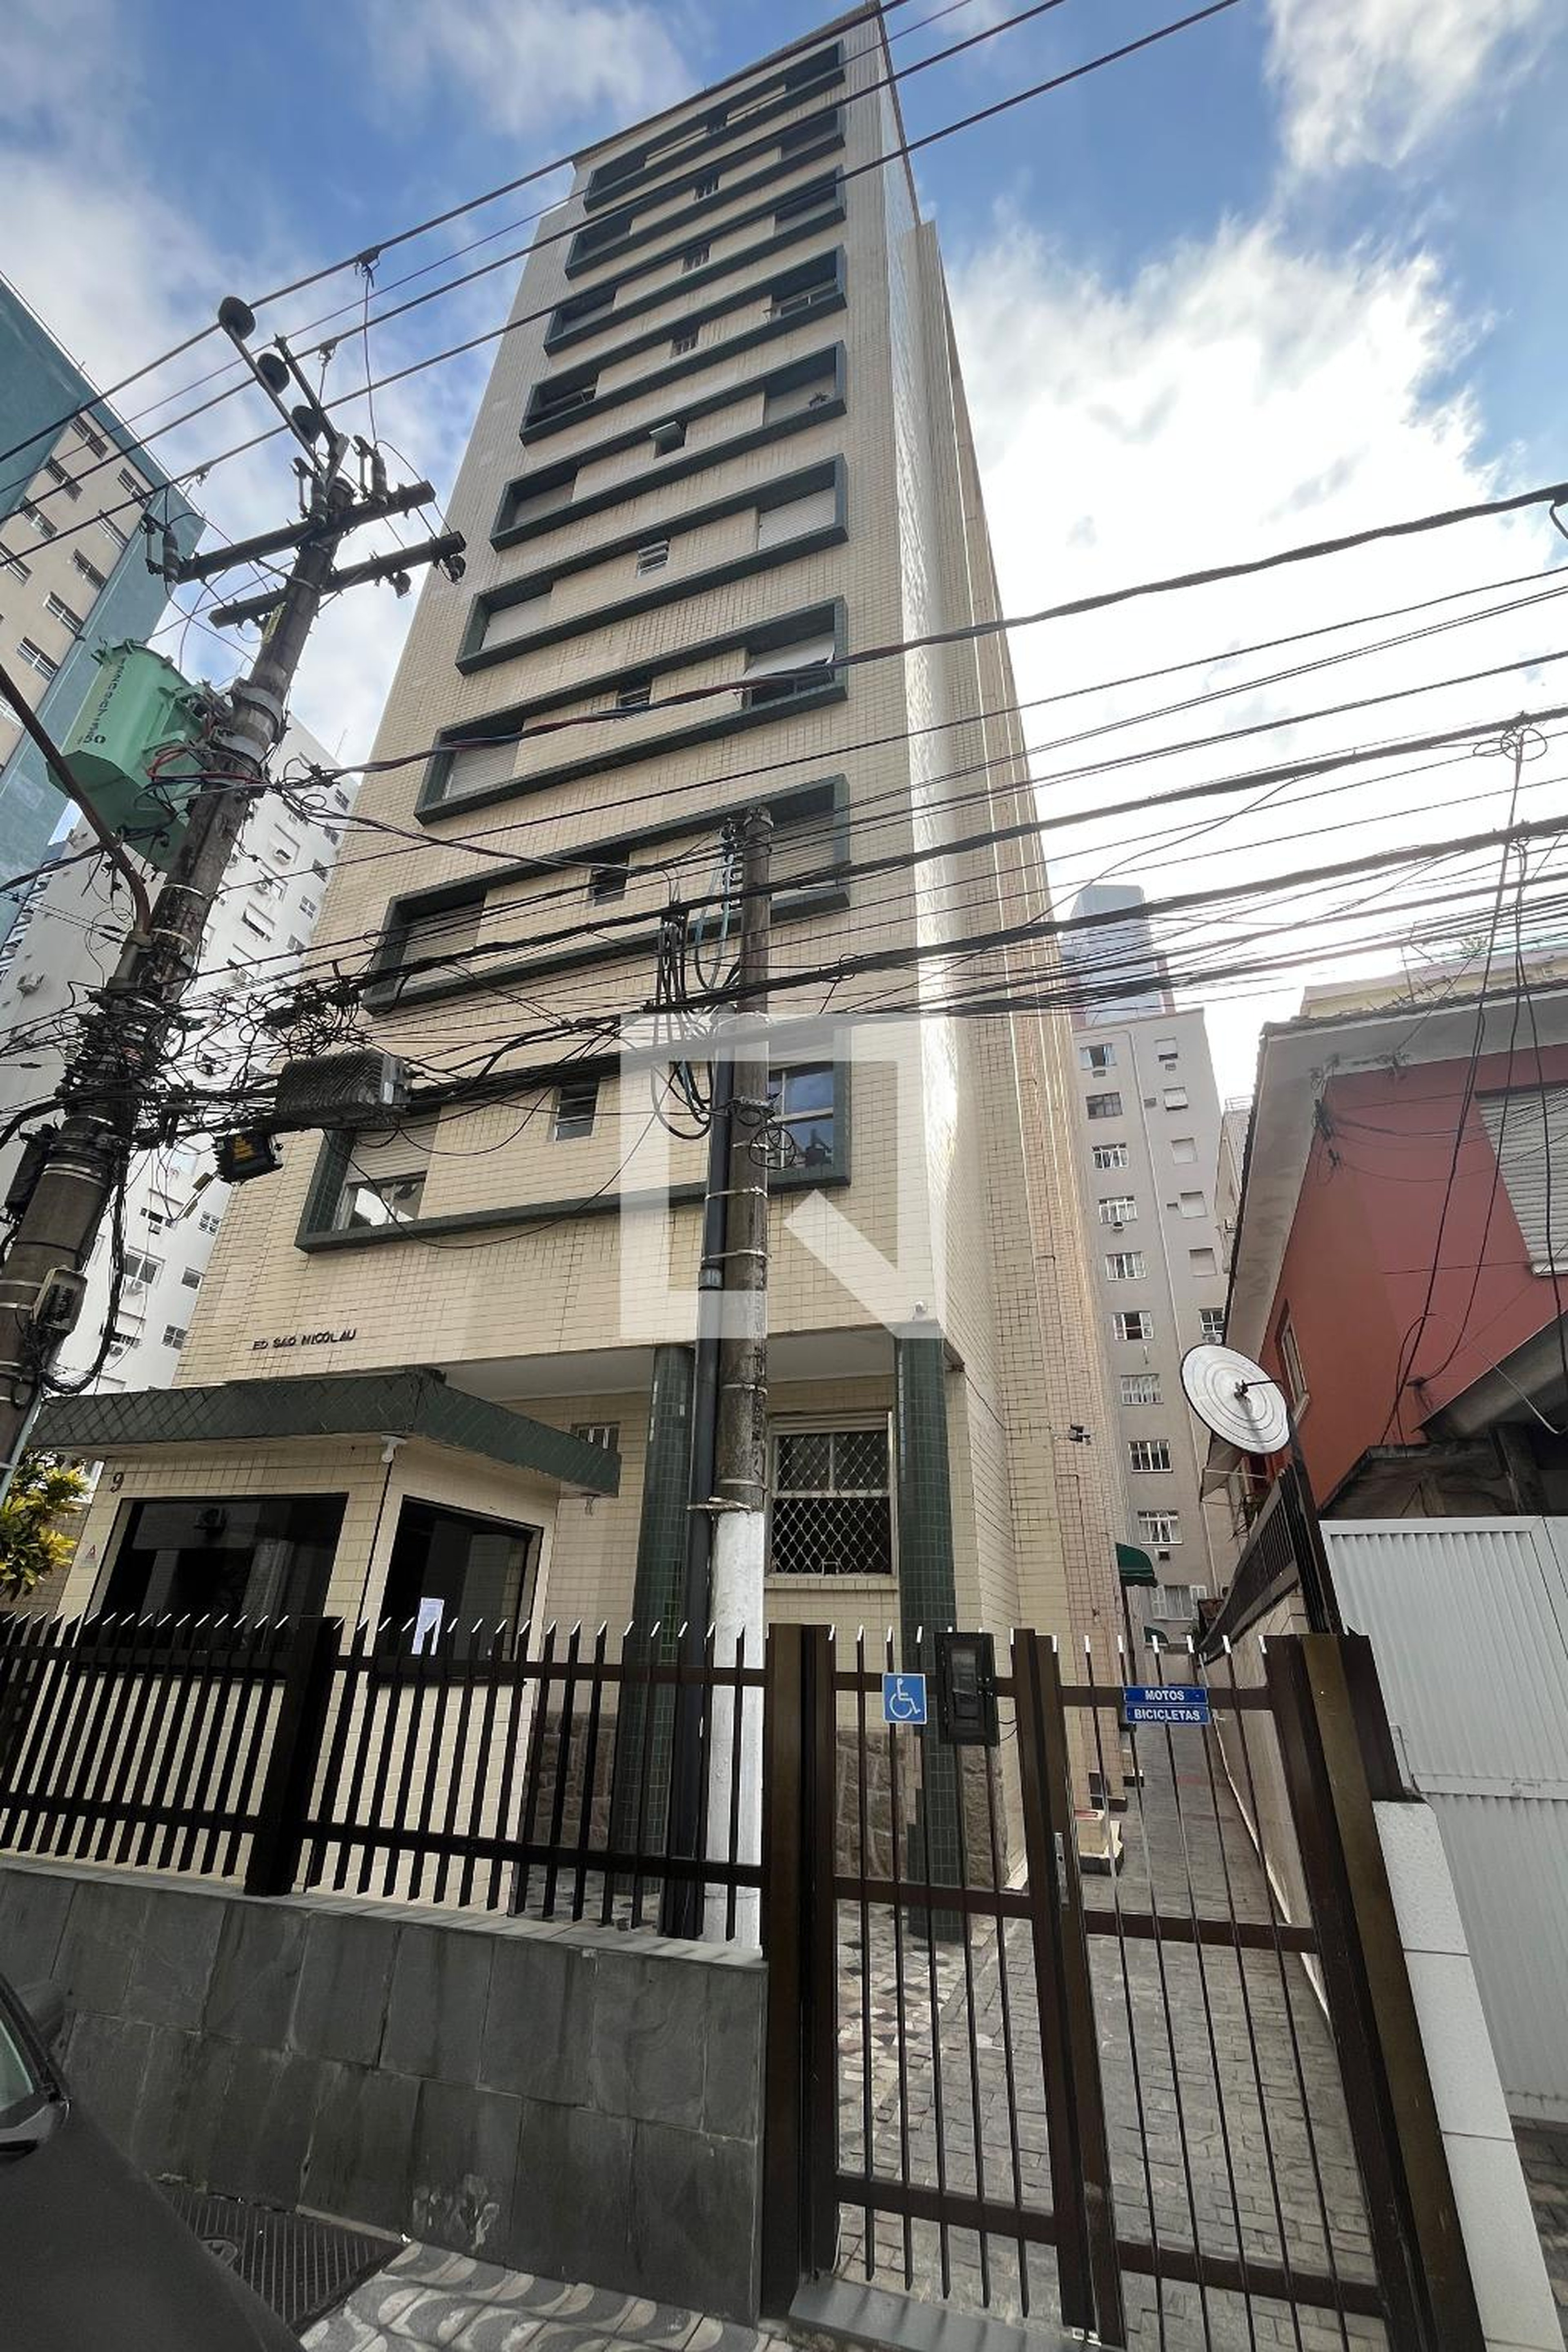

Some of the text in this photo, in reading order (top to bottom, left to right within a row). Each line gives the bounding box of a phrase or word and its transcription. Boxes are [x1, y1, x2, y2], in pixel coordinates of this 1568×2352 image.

[253, 1341, 268, 1350] ED
[301, 1329, 357, 1345] NICOLAU
[110, 1472, 124, 1493] 9
[1145, 1690, 1184, 1700] MOTOS
[1134, 1708, 1200, 1720] BICICLETAS
